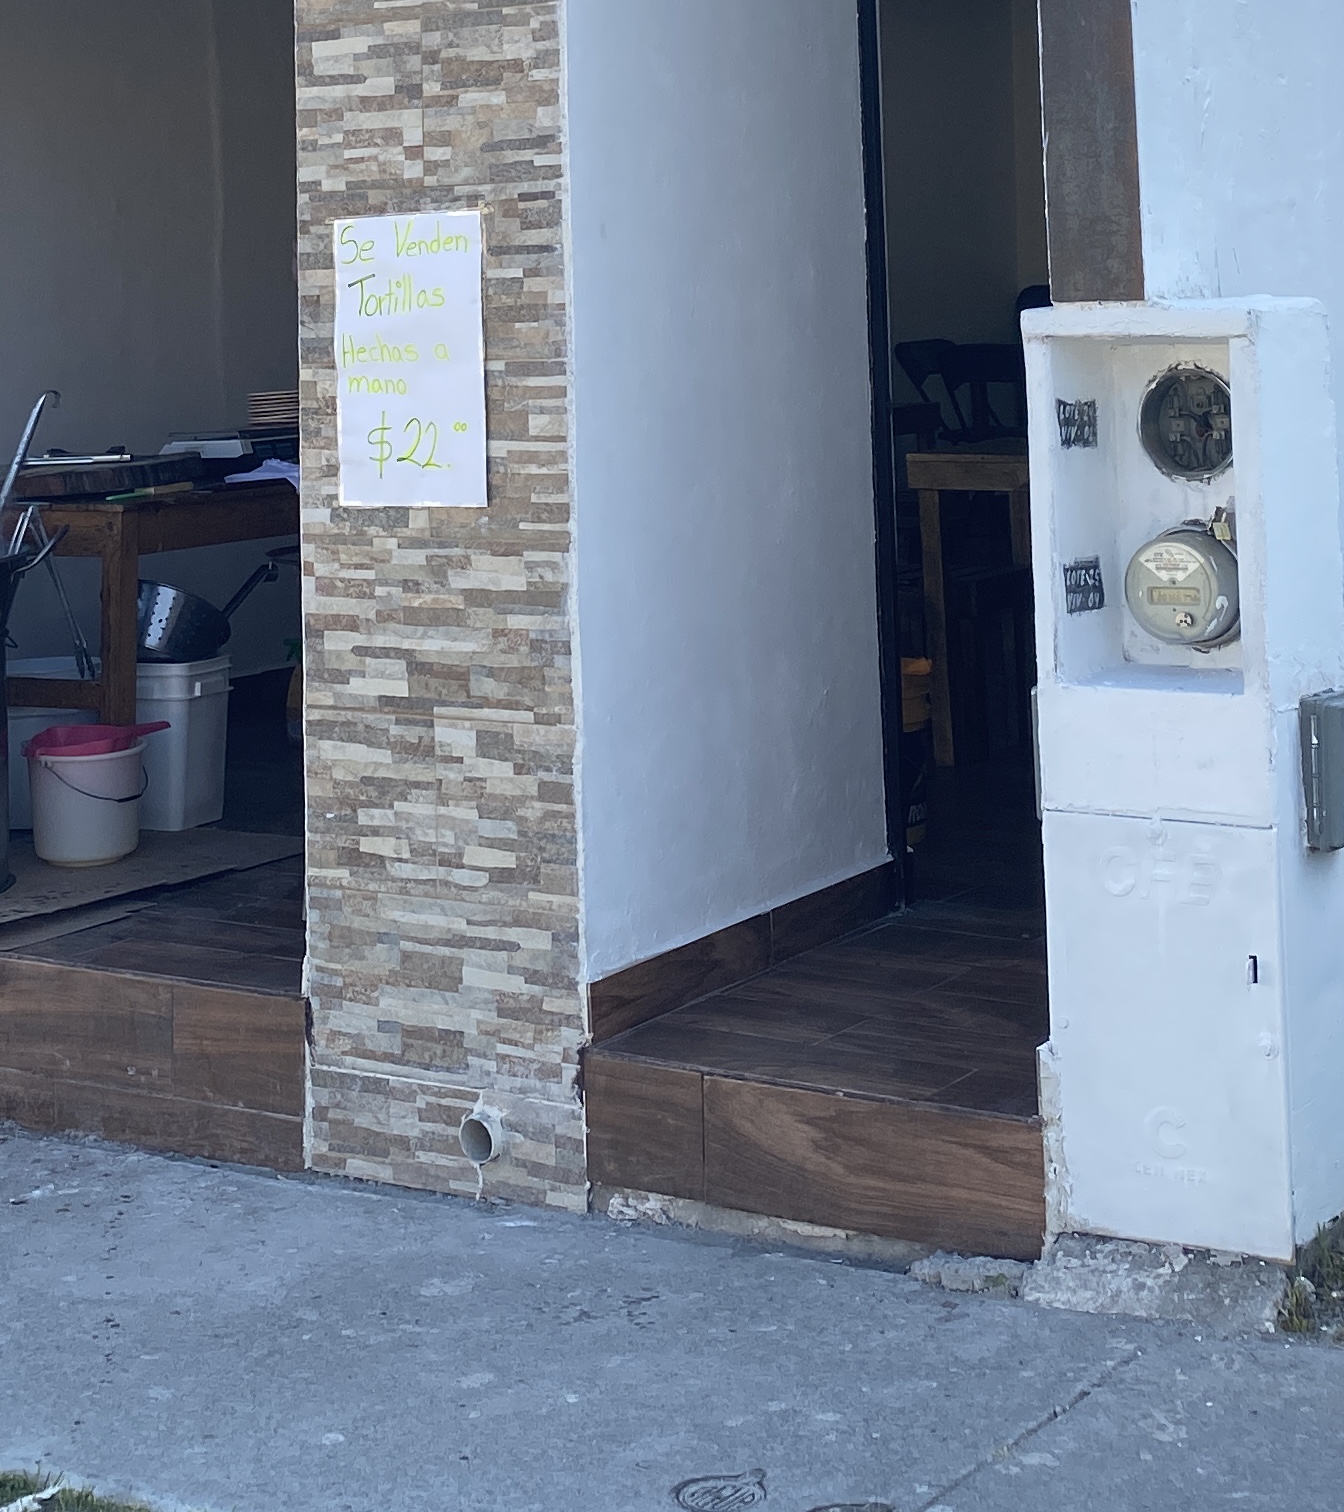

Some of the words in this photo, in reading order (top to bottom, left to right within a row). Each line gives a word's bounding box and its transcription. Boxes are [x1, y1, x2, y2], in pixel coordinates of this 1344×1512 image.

[341, 225, 375, 264] Se
[394, 220, 468, 258] Venden
[348, 273, 445, 317] Tortillas
[342, 332, 419, 367] Hechas
[434, 343, 451, 362] a
[348, 376, 408, 395] mano
